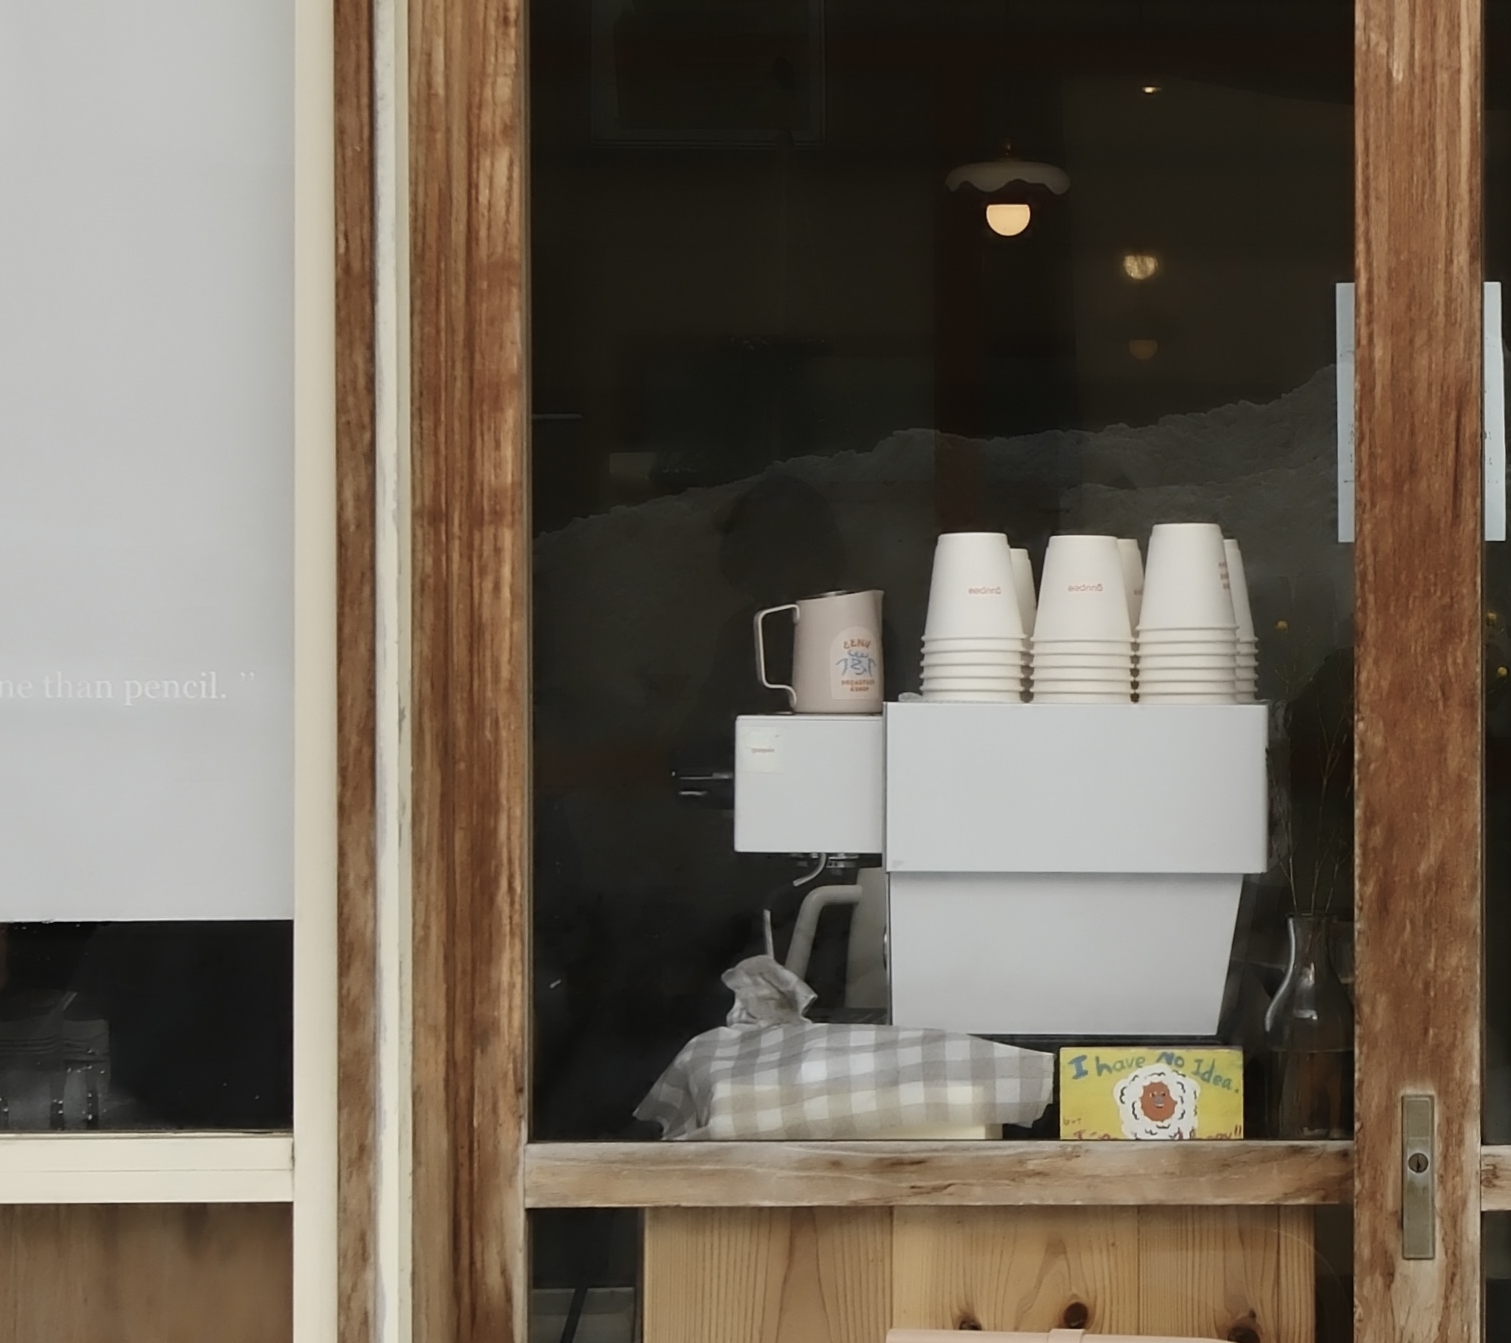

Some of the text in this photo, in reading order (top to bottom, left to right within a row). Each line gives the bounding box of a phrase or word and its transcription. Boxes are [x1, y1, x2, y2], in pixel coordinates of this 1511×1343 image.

[42, 670, 114, 700] than
[123, 670, 228, 707] pencil.
[1068, 1054, 1089, 1080] I
[1094, 1055, 1146, 1077] have
